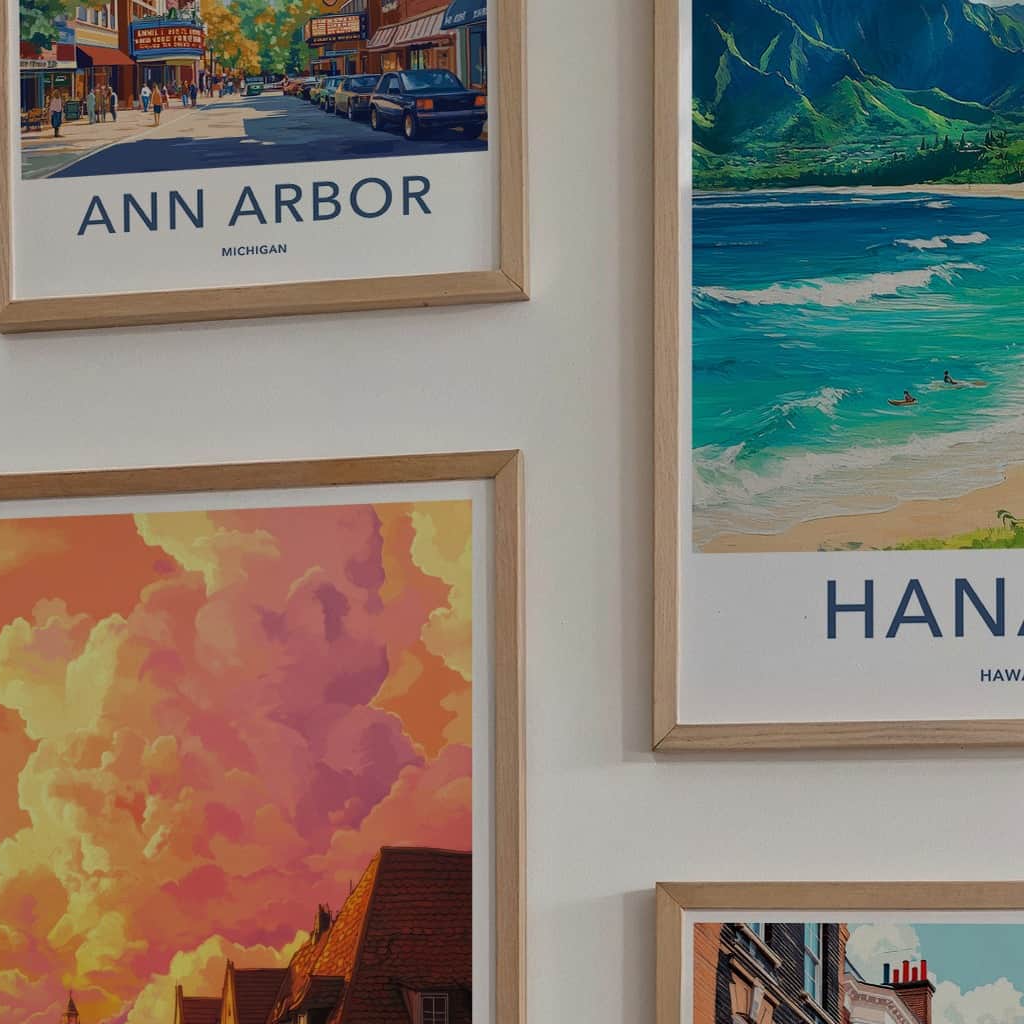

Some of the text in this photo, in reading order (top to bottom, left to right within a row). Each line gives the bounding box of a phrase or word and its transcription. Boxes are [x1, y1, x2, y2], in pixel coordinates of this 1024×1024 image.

[77, 175, 432, 236] ANN ARBOR
[221, 243, 288, 257] MICHIGAN
[827, 577, 1024, 639] HAN
[980, 668, 1024, 682] HAW
